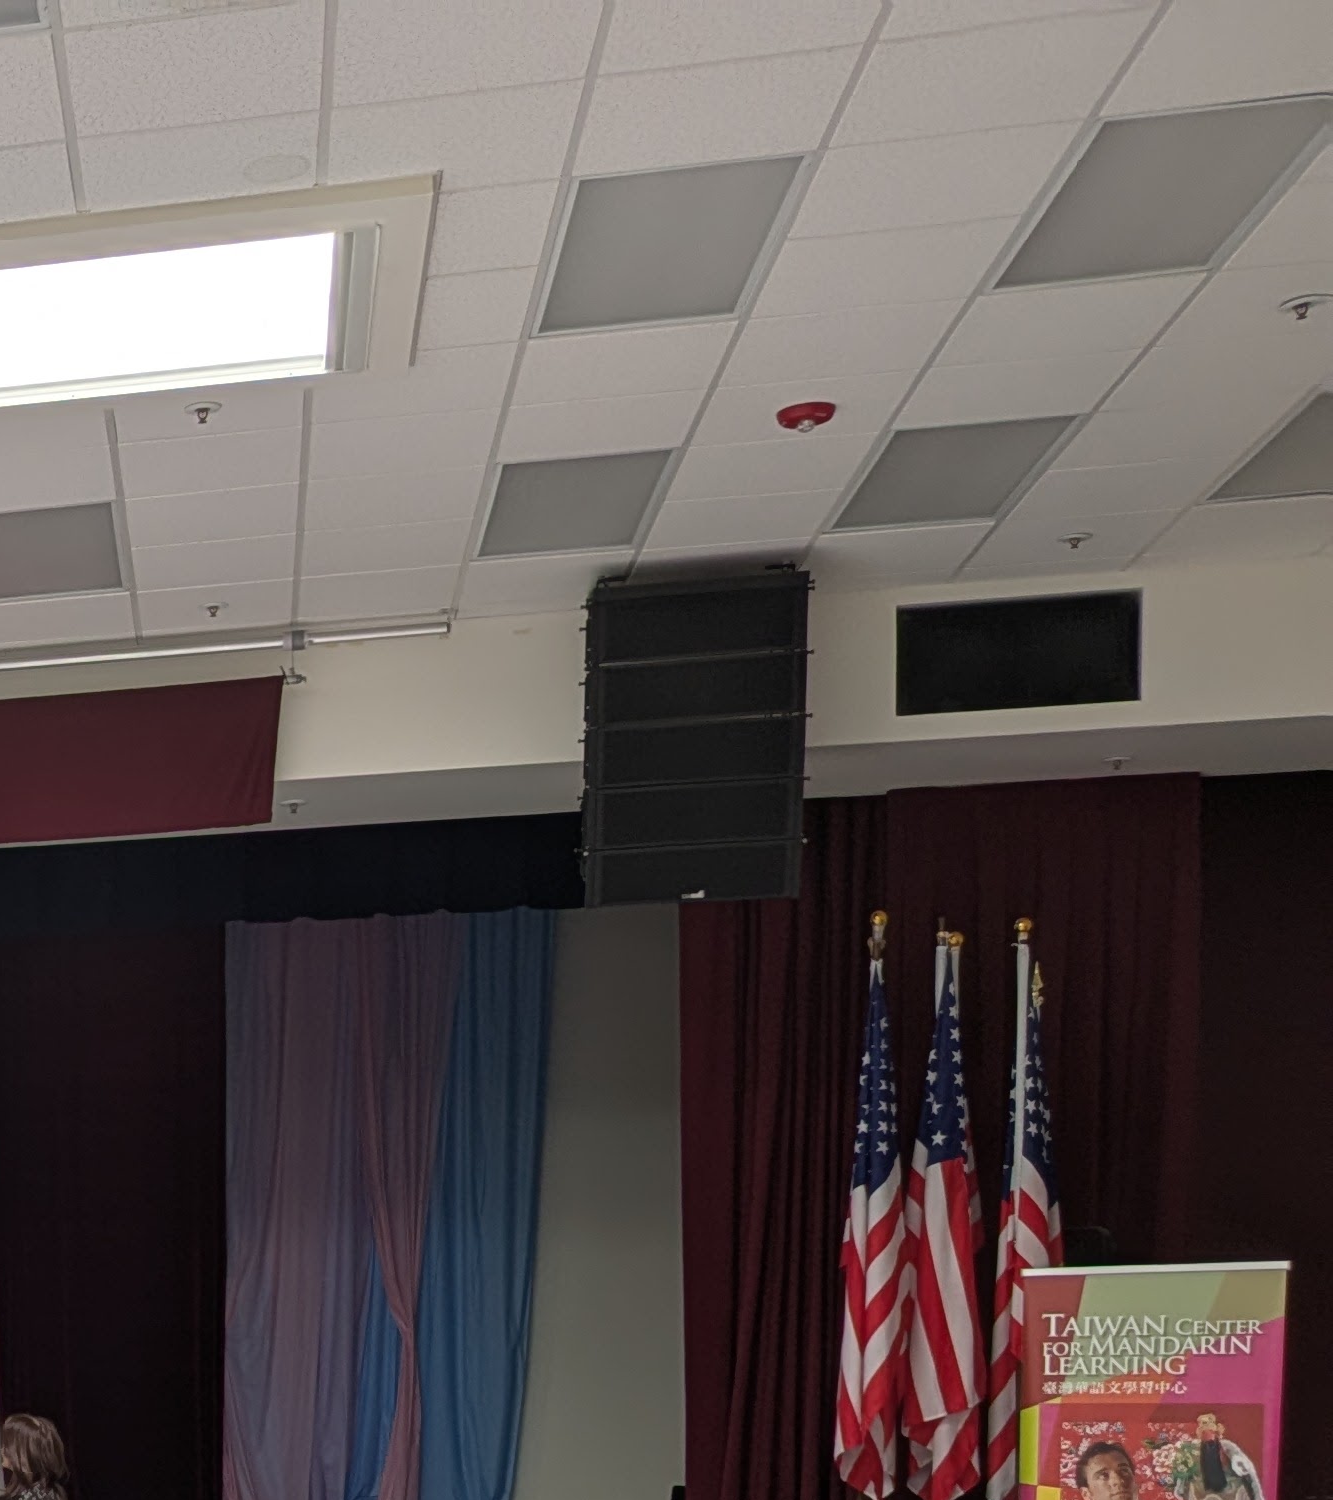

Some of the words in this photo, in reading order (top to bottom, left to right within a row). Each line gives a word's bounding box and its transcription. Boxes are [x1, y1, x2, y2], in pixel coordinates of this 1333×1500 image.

[1041, 1313, 1167, 1337] TAIWAN
[1175, 1318, 1263, 1335] CENTER
[1042, 1342, 1083, 1357] FOR
[1088, 1335, 1252, 1355] MANDARIN
[1042, 1354, 1187, 1376] LEARNING
